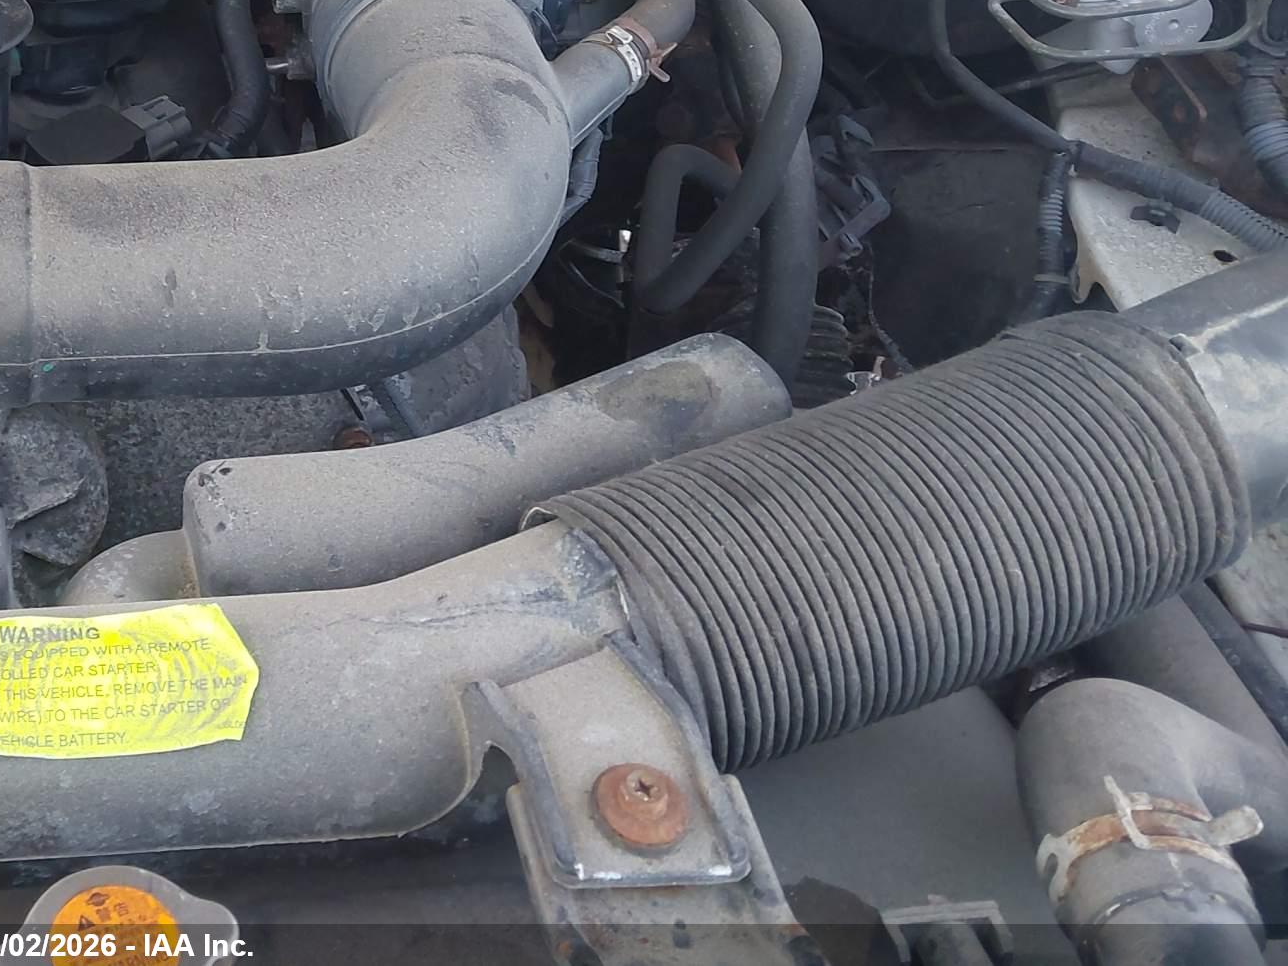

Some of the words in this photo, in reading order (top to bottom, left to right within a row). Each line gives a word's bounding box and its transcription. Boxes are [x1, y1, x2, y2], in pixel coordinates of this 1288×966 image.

[0, 625, 100, 645] WARNING
[15, 645, 89, 661] EQUIPPED
[92, 643, 133, 657] WITH
[135, 642, 147, 654] A
[148, 637, 210, 654] REMOTE
[53, 664, 85, 679] CAR
[2, 687, 37, 701] THIS
[113, 679, 176, 696] REMOVE
[179, 677, 209, 692] THE
[212, 673, 248, 689] MAIN
[45, 709, 67, 723] TO
[70, 706, 100, 721] THE
[103, 705, 135, 720] CAR
[139, 700, 206, 718] STARTER
[59, 731, 128, 748] BATTERY.
